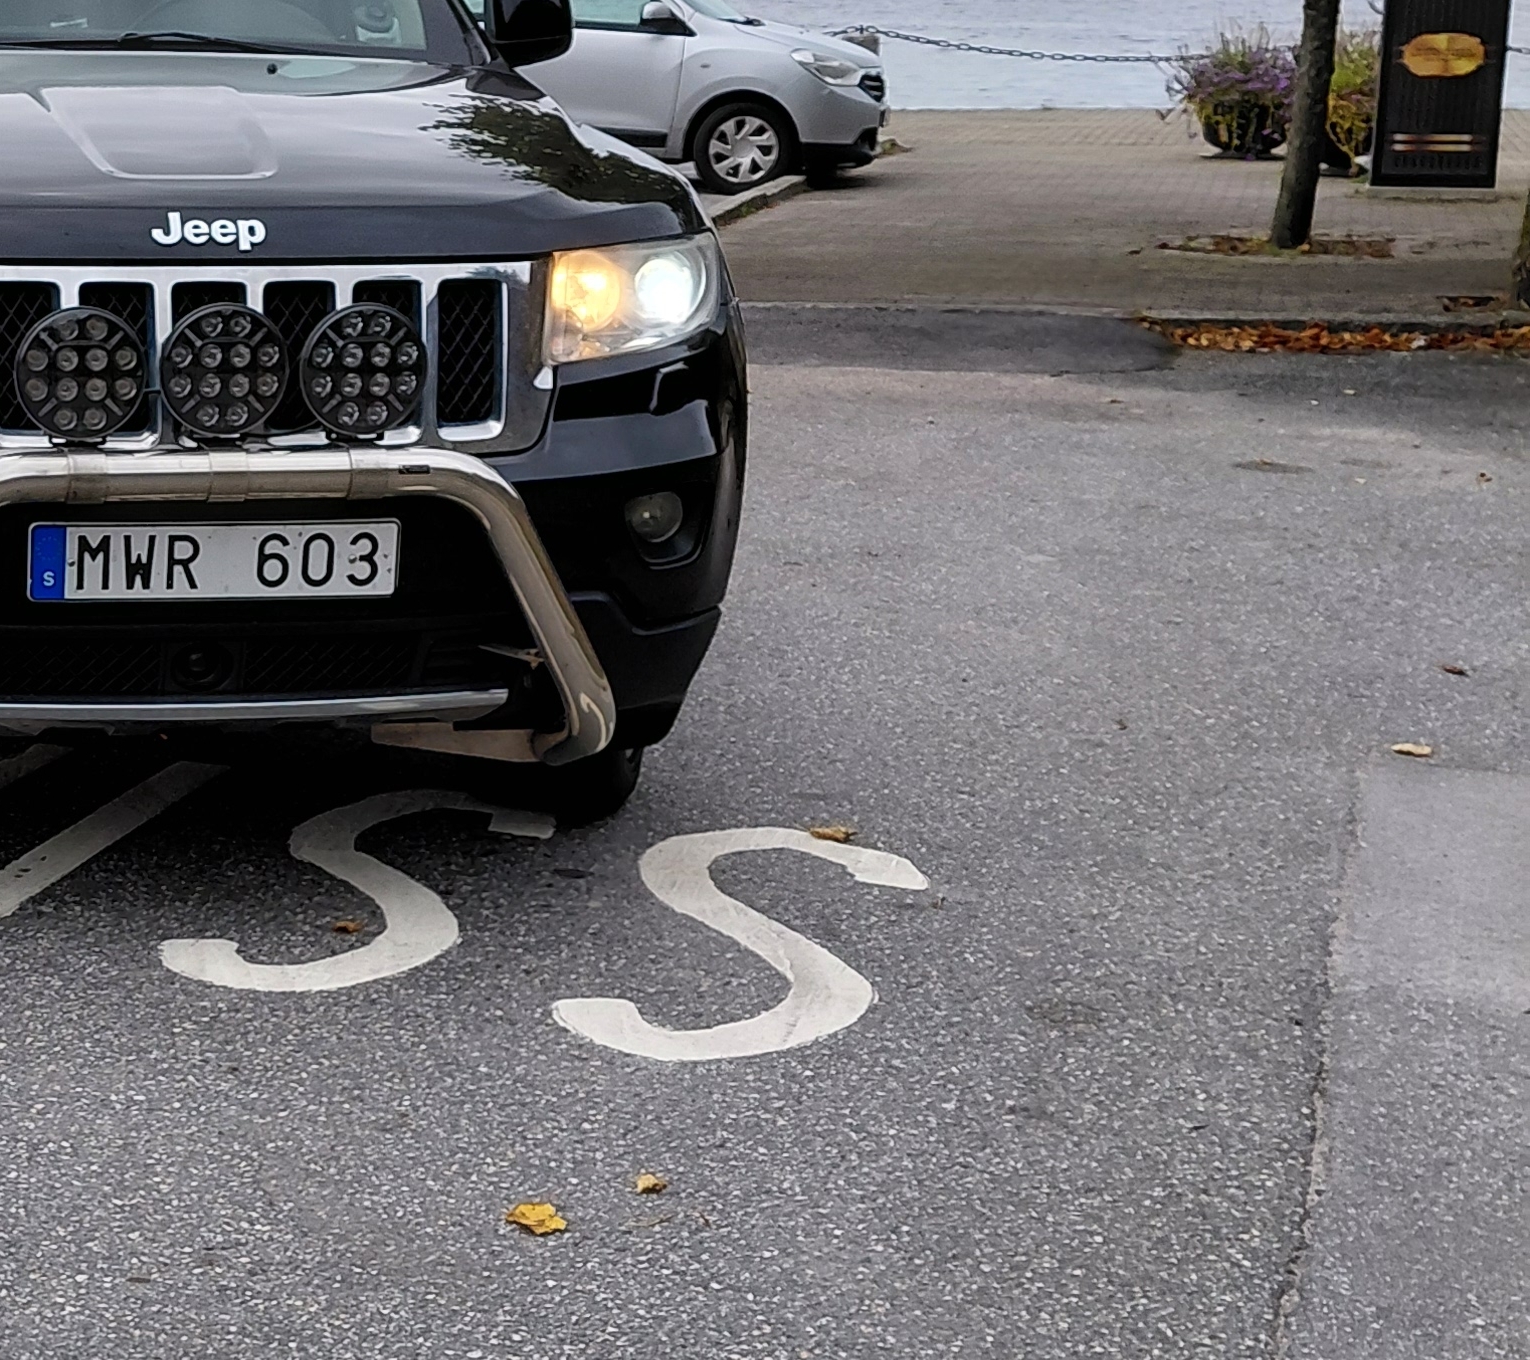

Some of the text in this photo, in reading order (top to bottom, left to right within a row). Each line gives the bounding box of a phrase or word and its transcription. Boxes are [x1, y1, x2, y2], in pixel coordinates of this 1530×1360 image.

[151, 212, 267, 251] Jeep
[43, 570, 55, 587] S
[75, 531, 381, 591] MWR 603
